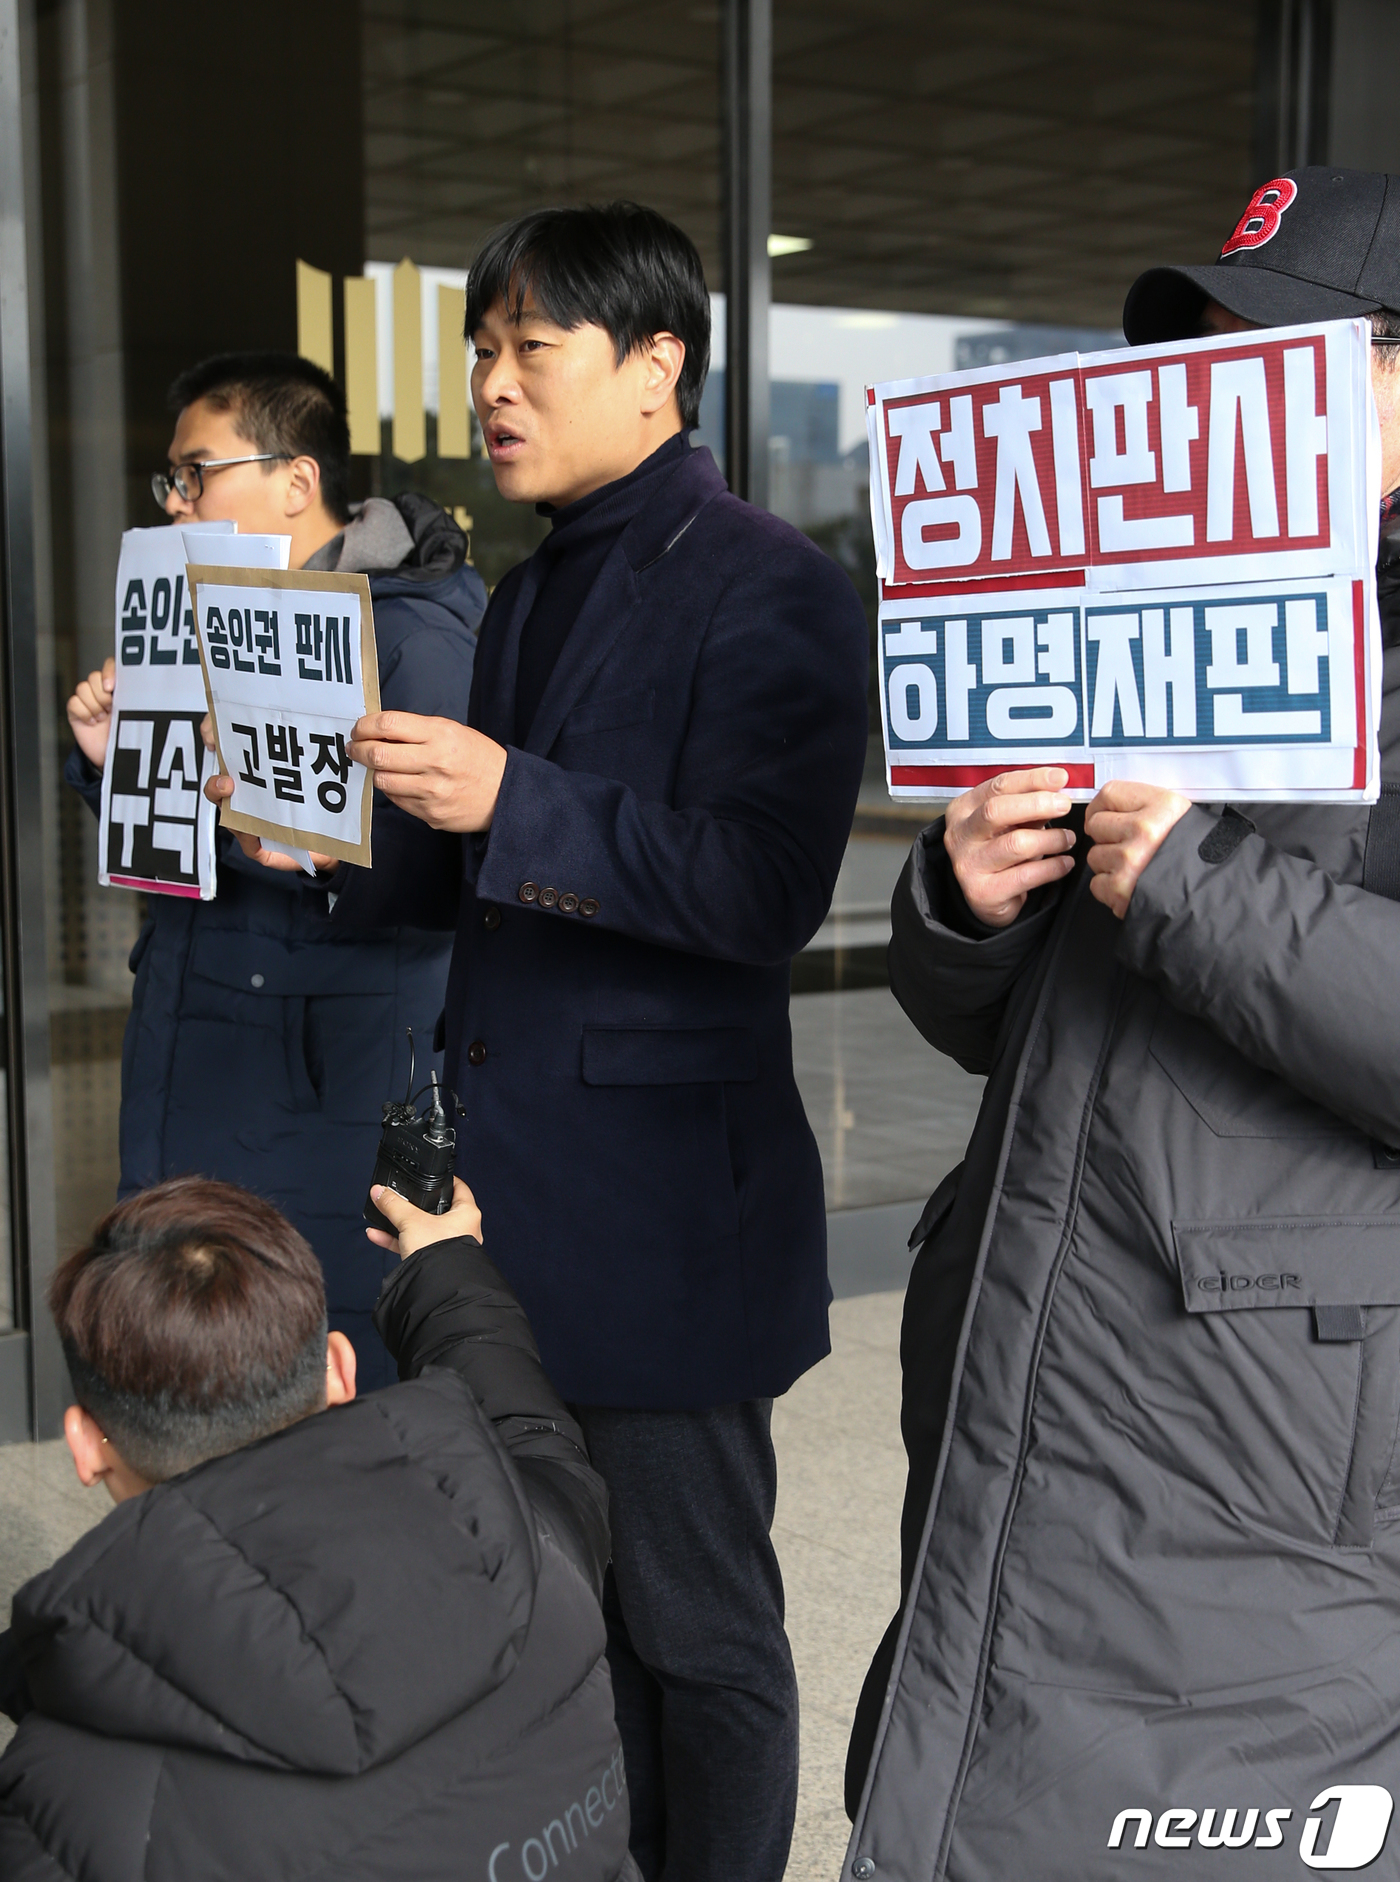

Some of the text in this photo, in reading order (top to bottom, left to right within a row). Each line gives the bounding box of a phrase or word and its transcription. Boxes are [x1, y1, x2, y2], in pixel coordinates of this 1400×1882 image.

[1220, 178, 1298, 259] B
[887, 345, 1328, 571] 정치판사
[206, 606, 282, 677] 송인권
[884, 599, 1329, 742] 하명재판
[111, 719, 198, 875] 구속
[231, 722, 353, 814] 고발장
